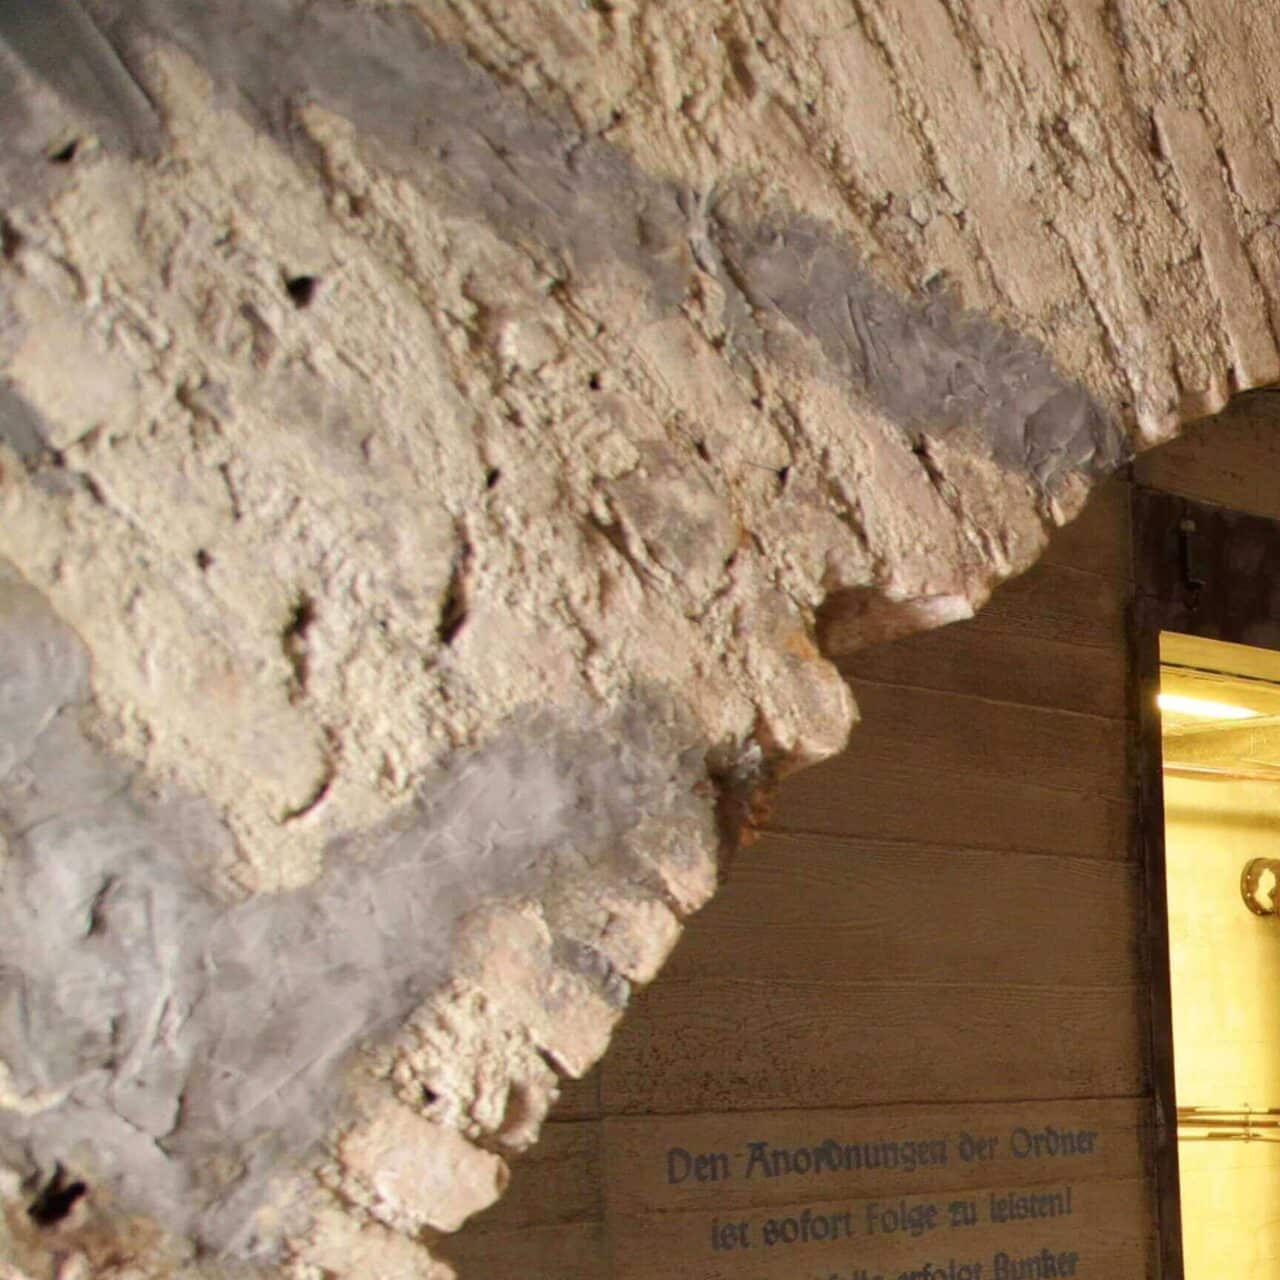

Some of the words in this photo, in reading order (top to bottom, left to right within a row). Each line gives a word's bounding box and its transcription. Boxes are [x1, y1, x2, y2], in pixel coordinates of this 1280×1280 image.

[667, 1147, 730, 1184] Den
[745, 1138, 948, 1178] Anordnungen
[959, 1131, 999, 1162] der
[1010, 1125, 1098, 1159] Ordner
[711, 1217, 750, 1249] ist
[763, 1208, 855, 1246] sofort
[866, 1201, 938, 1237] Folge
[948, 1200, 978, 1227] zu
